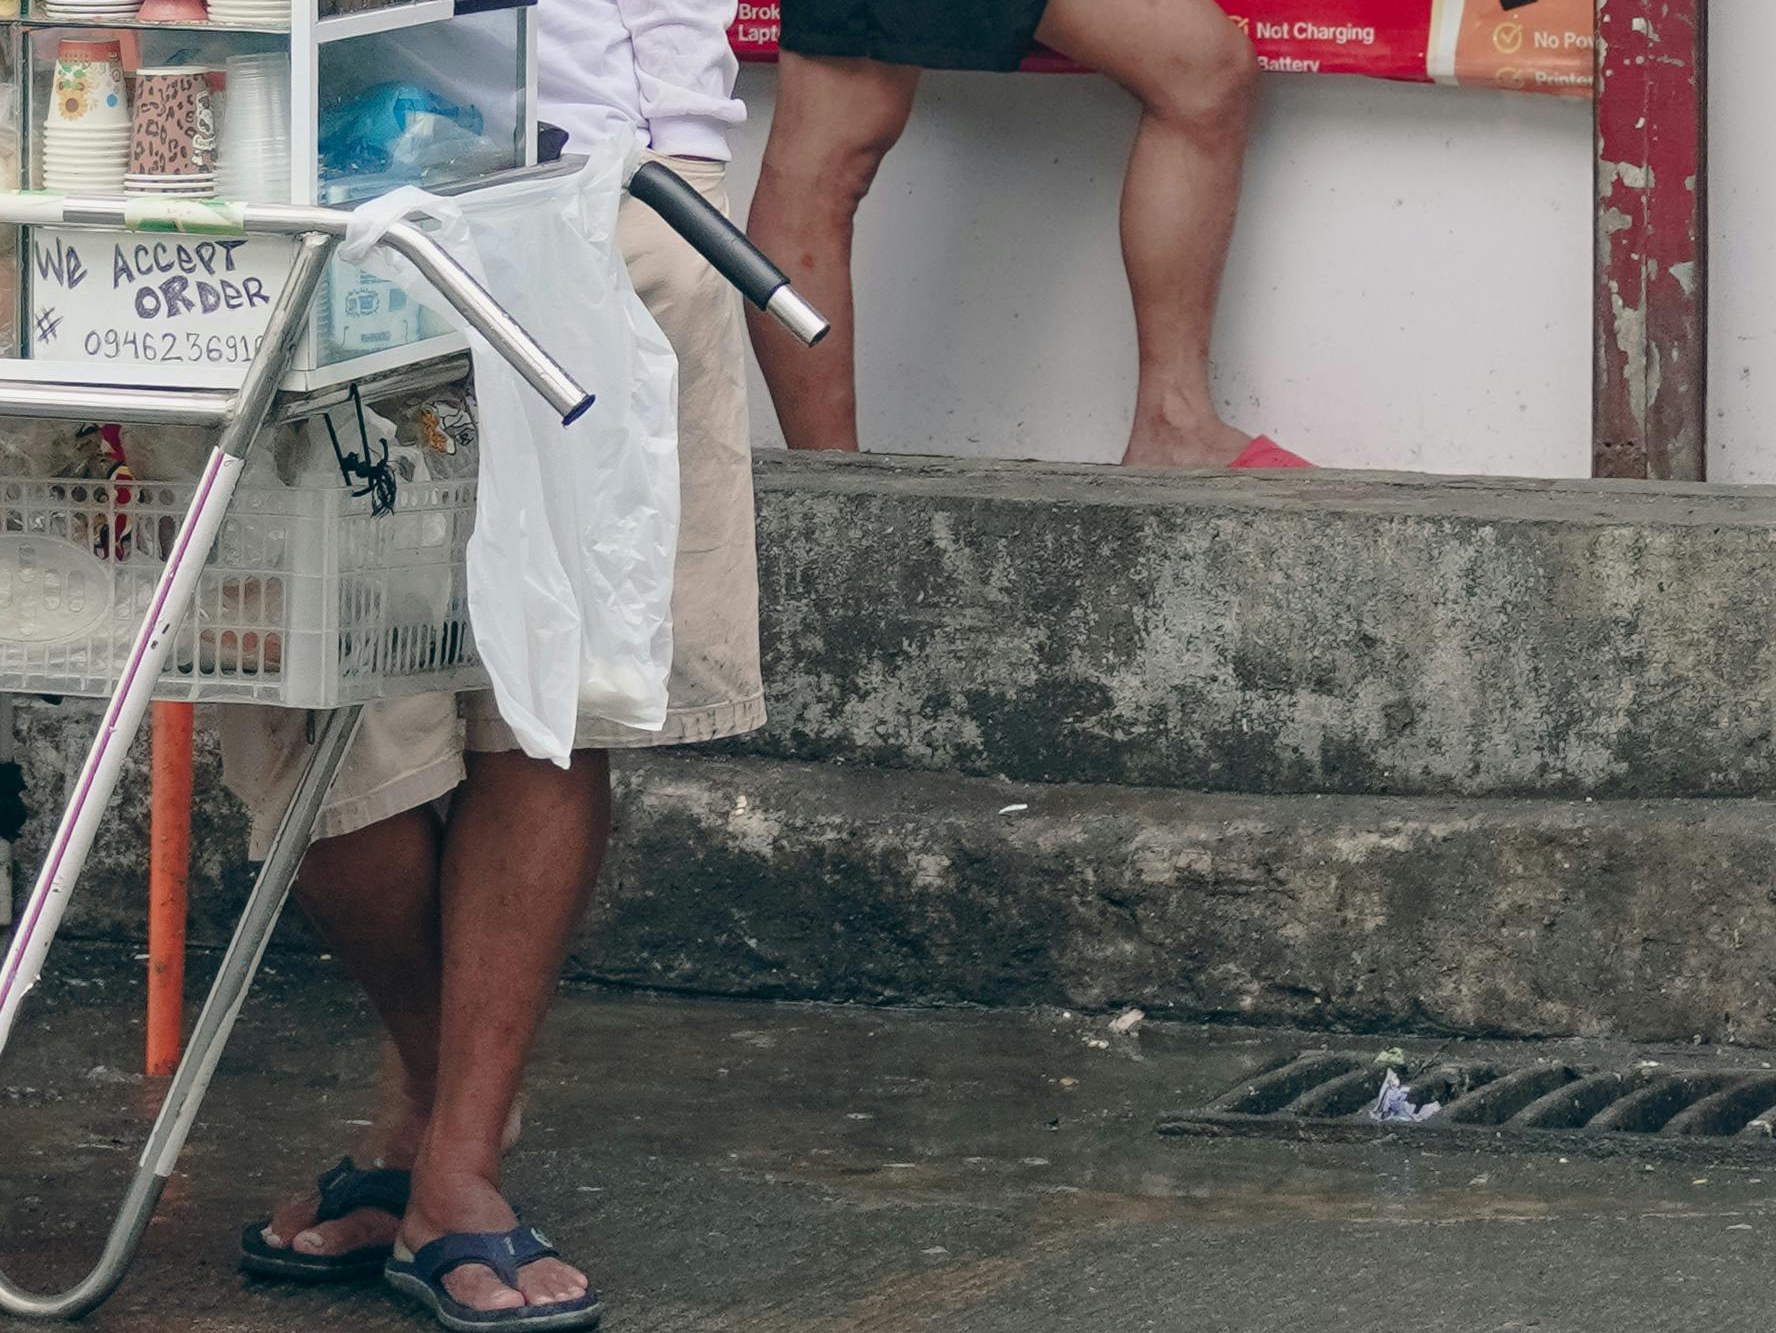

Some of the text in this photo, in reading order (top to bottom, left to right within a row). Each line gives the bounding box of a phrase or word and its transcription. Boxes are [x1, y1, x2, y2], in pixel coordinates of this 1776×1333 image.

[1256, 22, 1376, 45] Not Charging
[1534, 31, 1560, 49] No
[1257, 56, 1320, 72] Battery
